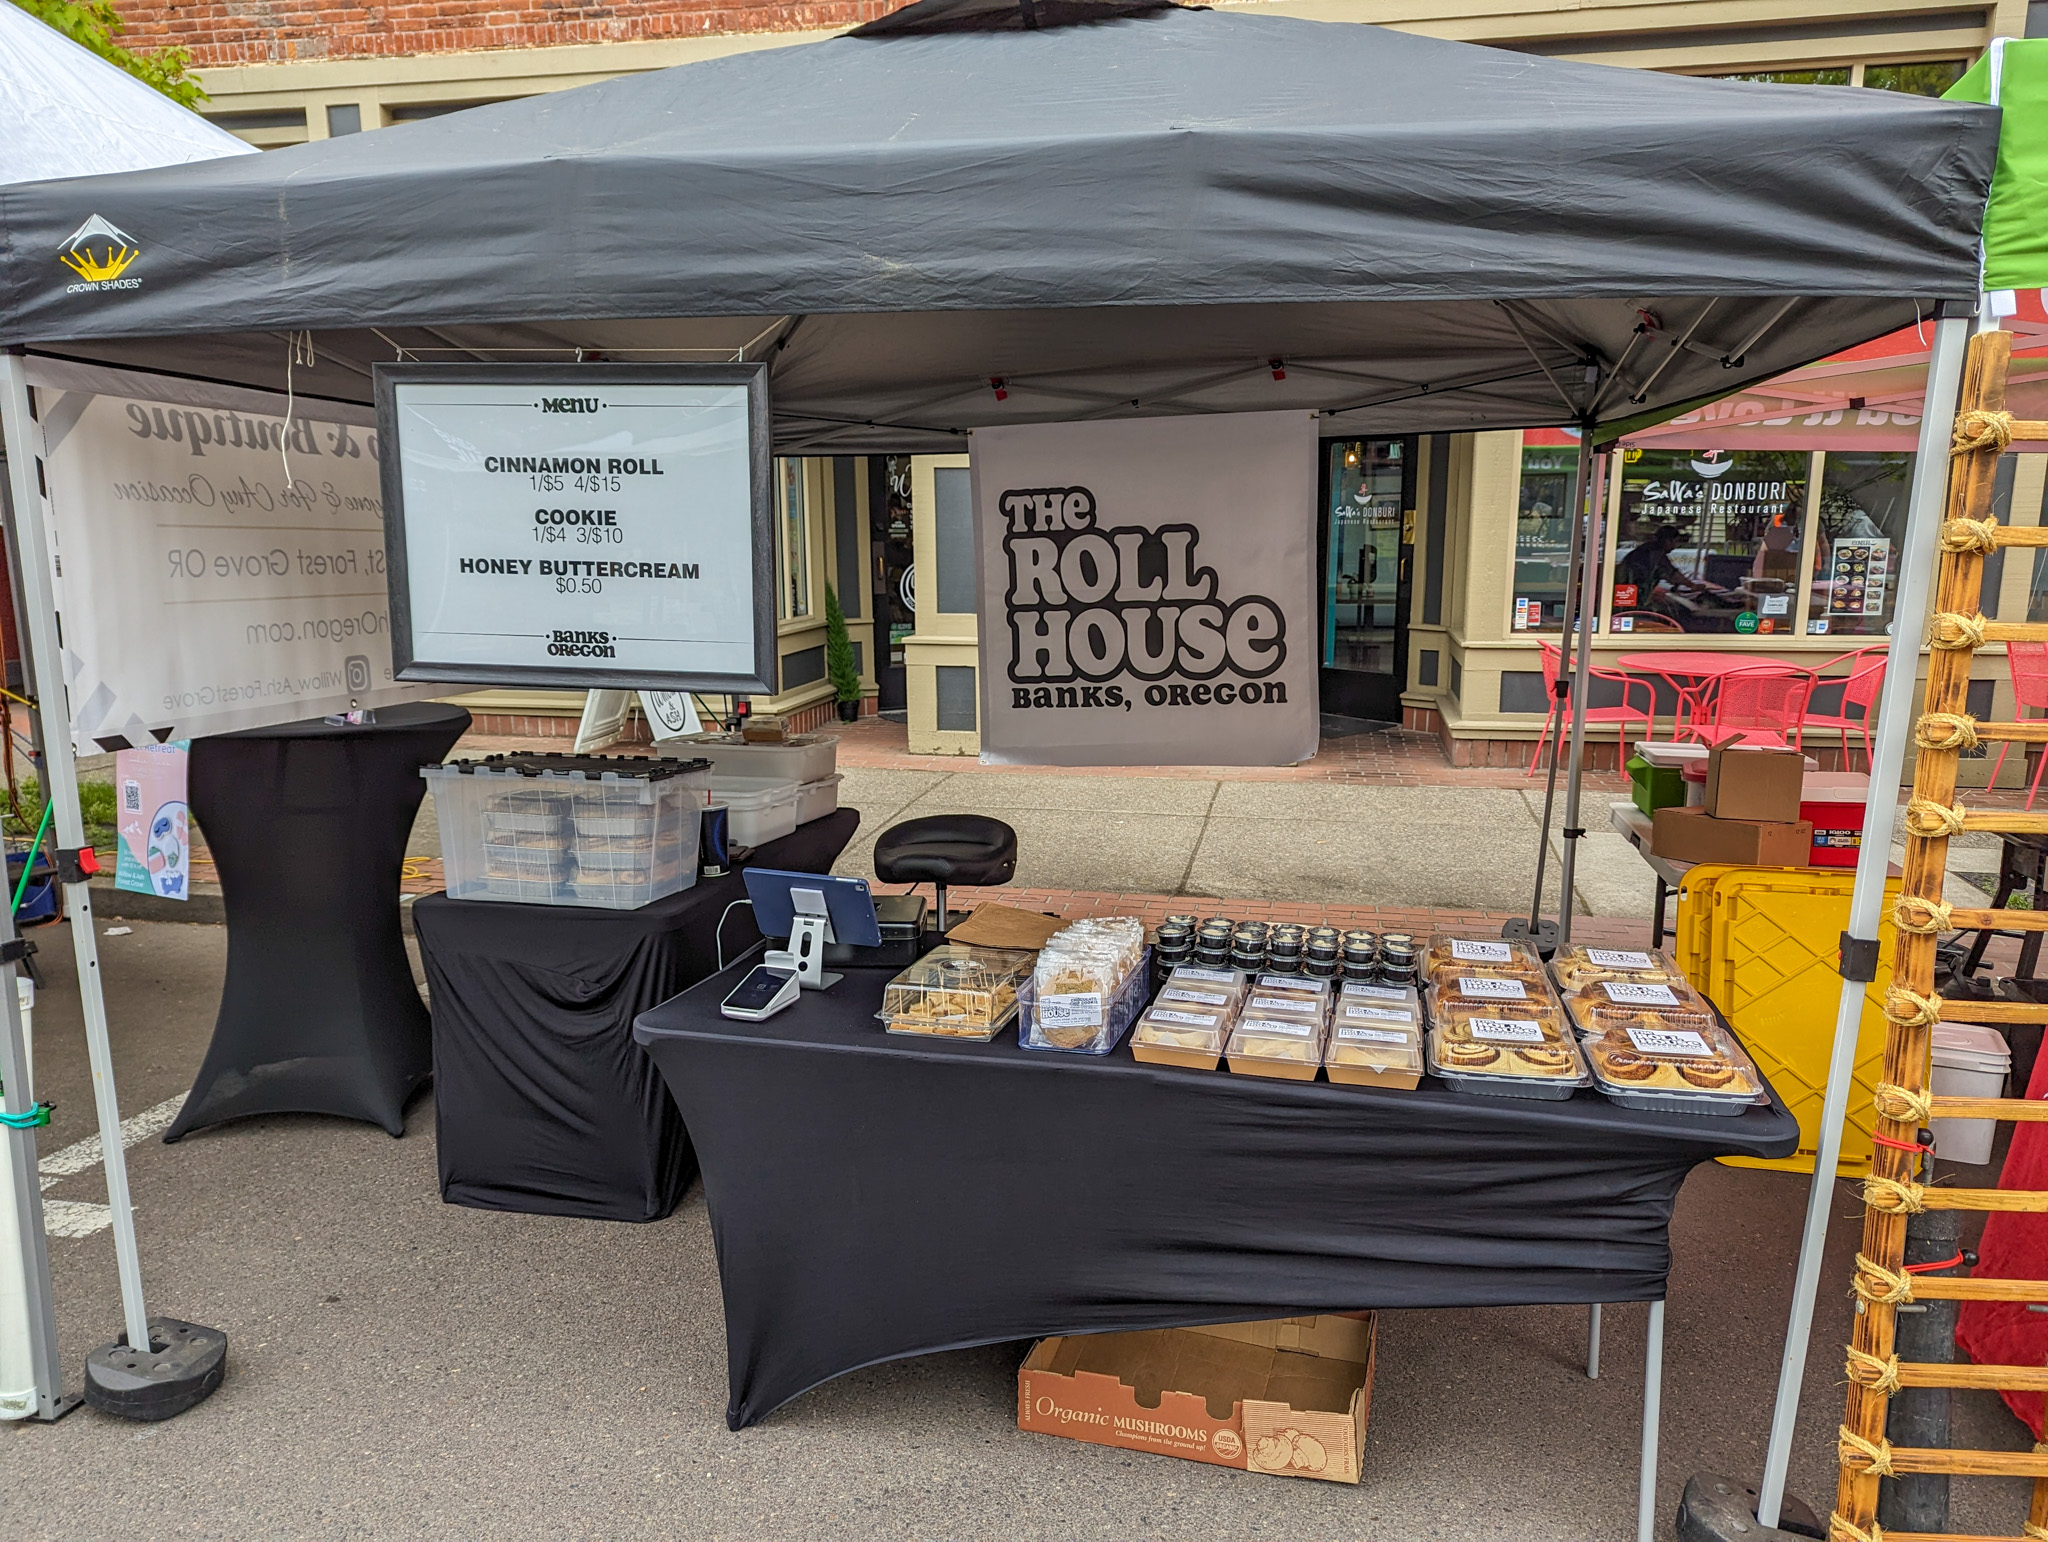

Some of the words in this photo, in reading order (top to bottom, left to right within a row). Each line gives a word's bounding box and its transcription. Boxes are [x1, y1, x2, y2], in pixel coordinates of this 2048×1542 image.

[67, 282, 99, 293] CROWN
[484, 457, 602, 475] CINNAMON
[608, 458, 664, 475] ROLL
[529, 475, 564, 493] 1/$5
[574, 475, 621, 493] 4/$15
[1711, 482, 1787, 501] DONBURI
[534, 508, 617, 526] COOKIE
[1362, 506, 1395, 518] DONBURI
[1641, 503, 1702, 516] Japanese
[1710, 503, 1785, 514] Restaurant
[532, 526, 567, 544] 1/$4
[576, 527, 623, 544] 3/$10
[459, 557, 532, 576] HONEY
[539, 560, 700, 580] BUTTERCREAM
[1007, 527, 1215, 607] ROLL
[555, 578, 603, 595] $0.50
[665, 710, 682, 724] ASH
[1035, 1396, 1109, 1426] Organic
[1113, 1415, 1208, 1442] MUSHROOMS
[1115, 1430, 1148, 1443] Champions
[1147, 1435, 1163, 1445] from
[1163, 1437, 1173, 1445] the
[1173, 1439, 1195, 1450] ground
[1195, 1443, 1207, 1452] up!
[1216, 1442, 1241, 1452] ORGANIC
[1218, 1434, 1236, 1444] USDA
